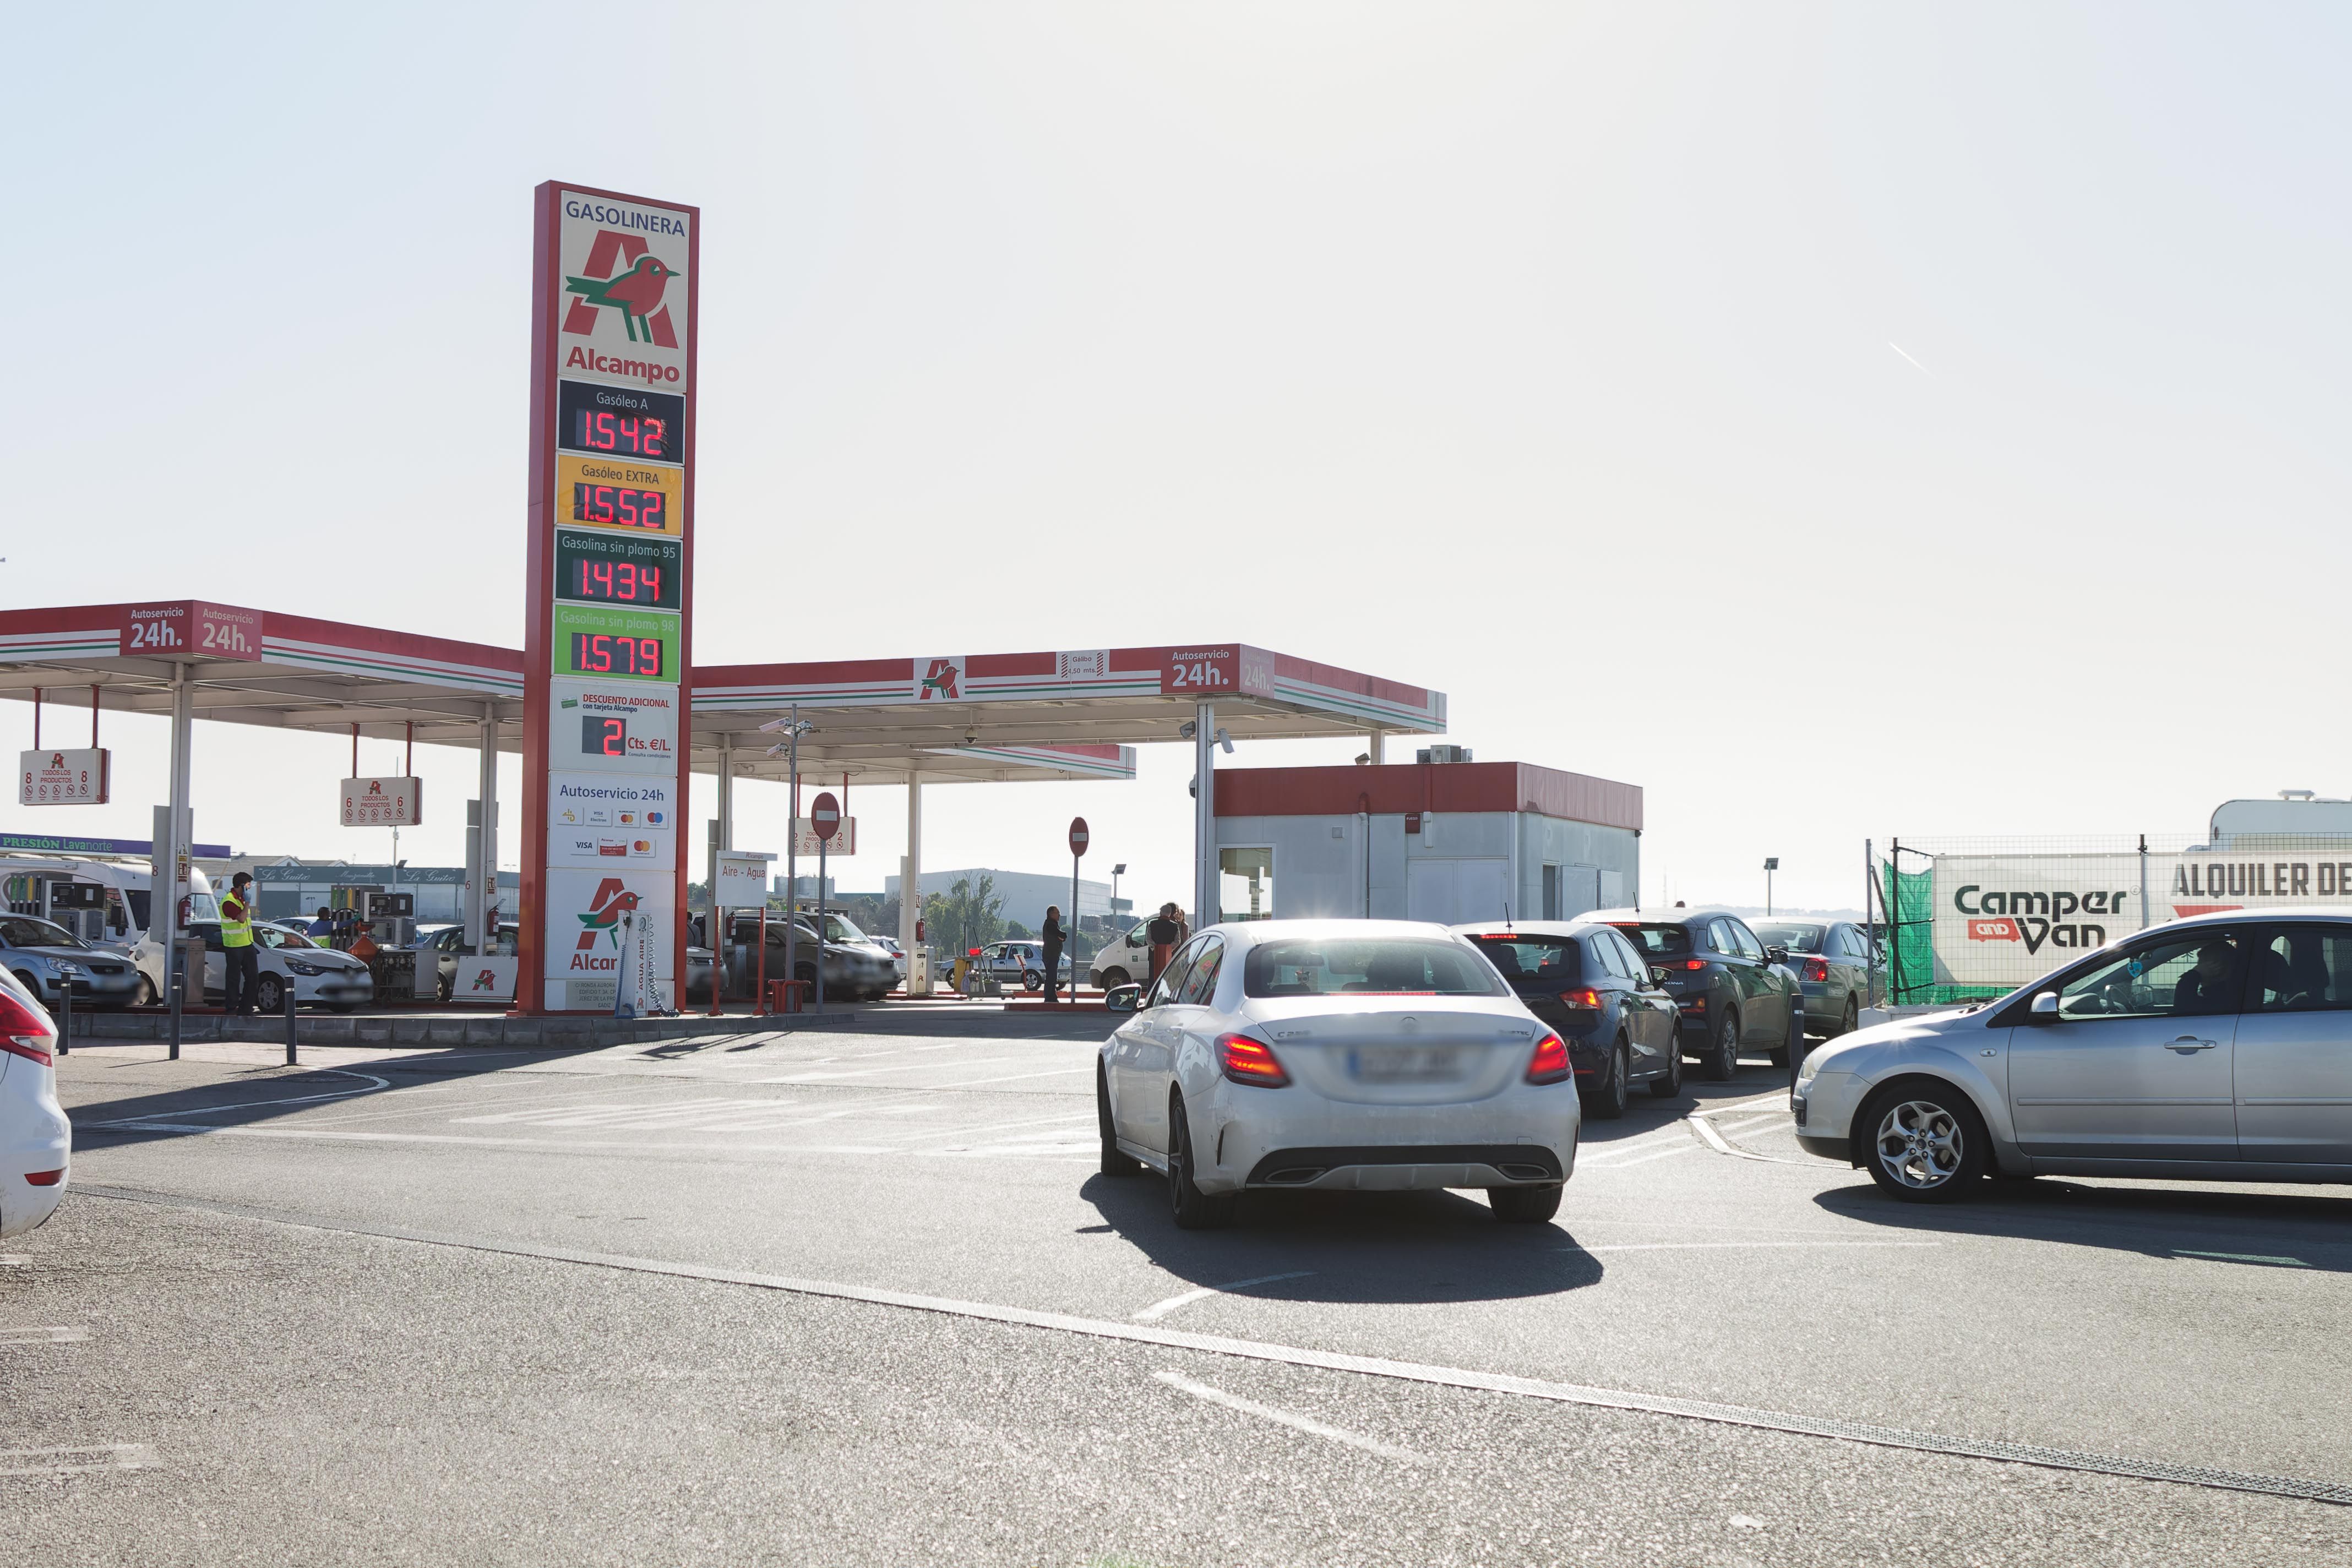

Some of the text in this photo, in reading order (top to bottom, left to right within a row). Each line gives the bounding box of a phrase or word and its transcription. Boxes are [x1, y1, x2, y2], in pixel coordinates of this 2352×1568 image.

[566, 200, 685, 237] GASOLINERA
[566, 346, 679, 384] Alcampo
[596, 392, 648, 410] Gasóleo A
[585, 411, 662, 455] 1.542
[582, 465, 659, 484] Gasóleo EXTRA
[584, 485, 661, 528] 1.552
[562, 536, 676, 558] Gasolina sin plomo 95
[582, 559, 660, 602] 1.434
[131, 607, 184, 619] Autoservicio
[203, 608, 254, 625] Autoservicio
[560, 611, 674, 631] Gasolina sin plomo 98
[130, 619, 183, 648] 24h.
[202, 623, 252, 653] 24h.
[581, 634, 658, 675] 1.579
[1172, 650, 1229, 661] Autoservicio
[1172, 661, 1229, 687] 24h.
[582, 694, 669, 708] DESCUENTO ADICIONAL
[613, 705, 638, 714] Alcampo
[603, 720, 622, 756] 2
[628, 737, 671, 752] Cts. €/L.
[26, 772, 32, 784] 8
[81, 771, 88, 782] 8
[560, 785, 664, 801] Autoservicio 24h
[346, 797, 352, 808] 6
[398, 796, 403, 807] 6
[3, 837, 113, 851] PRESIÓN Lavanorte
[837, 832, 842, 841] 2
[152, 865, 158, 876] 8
[260, 868, 275, 880] La
[404, 870, 455, 881] La Guita
[722, 865, 738, 876] Aire
[747, 867, 765, 880] Agua
[465, 881, 471, 890] 6
[2171, 862, 2352, 899] ALQUILER DE
[707, 889, 711, 899] 4
[1954, 885, 2127, 922] Camper
[2014, 917, 2106, 955] Van
